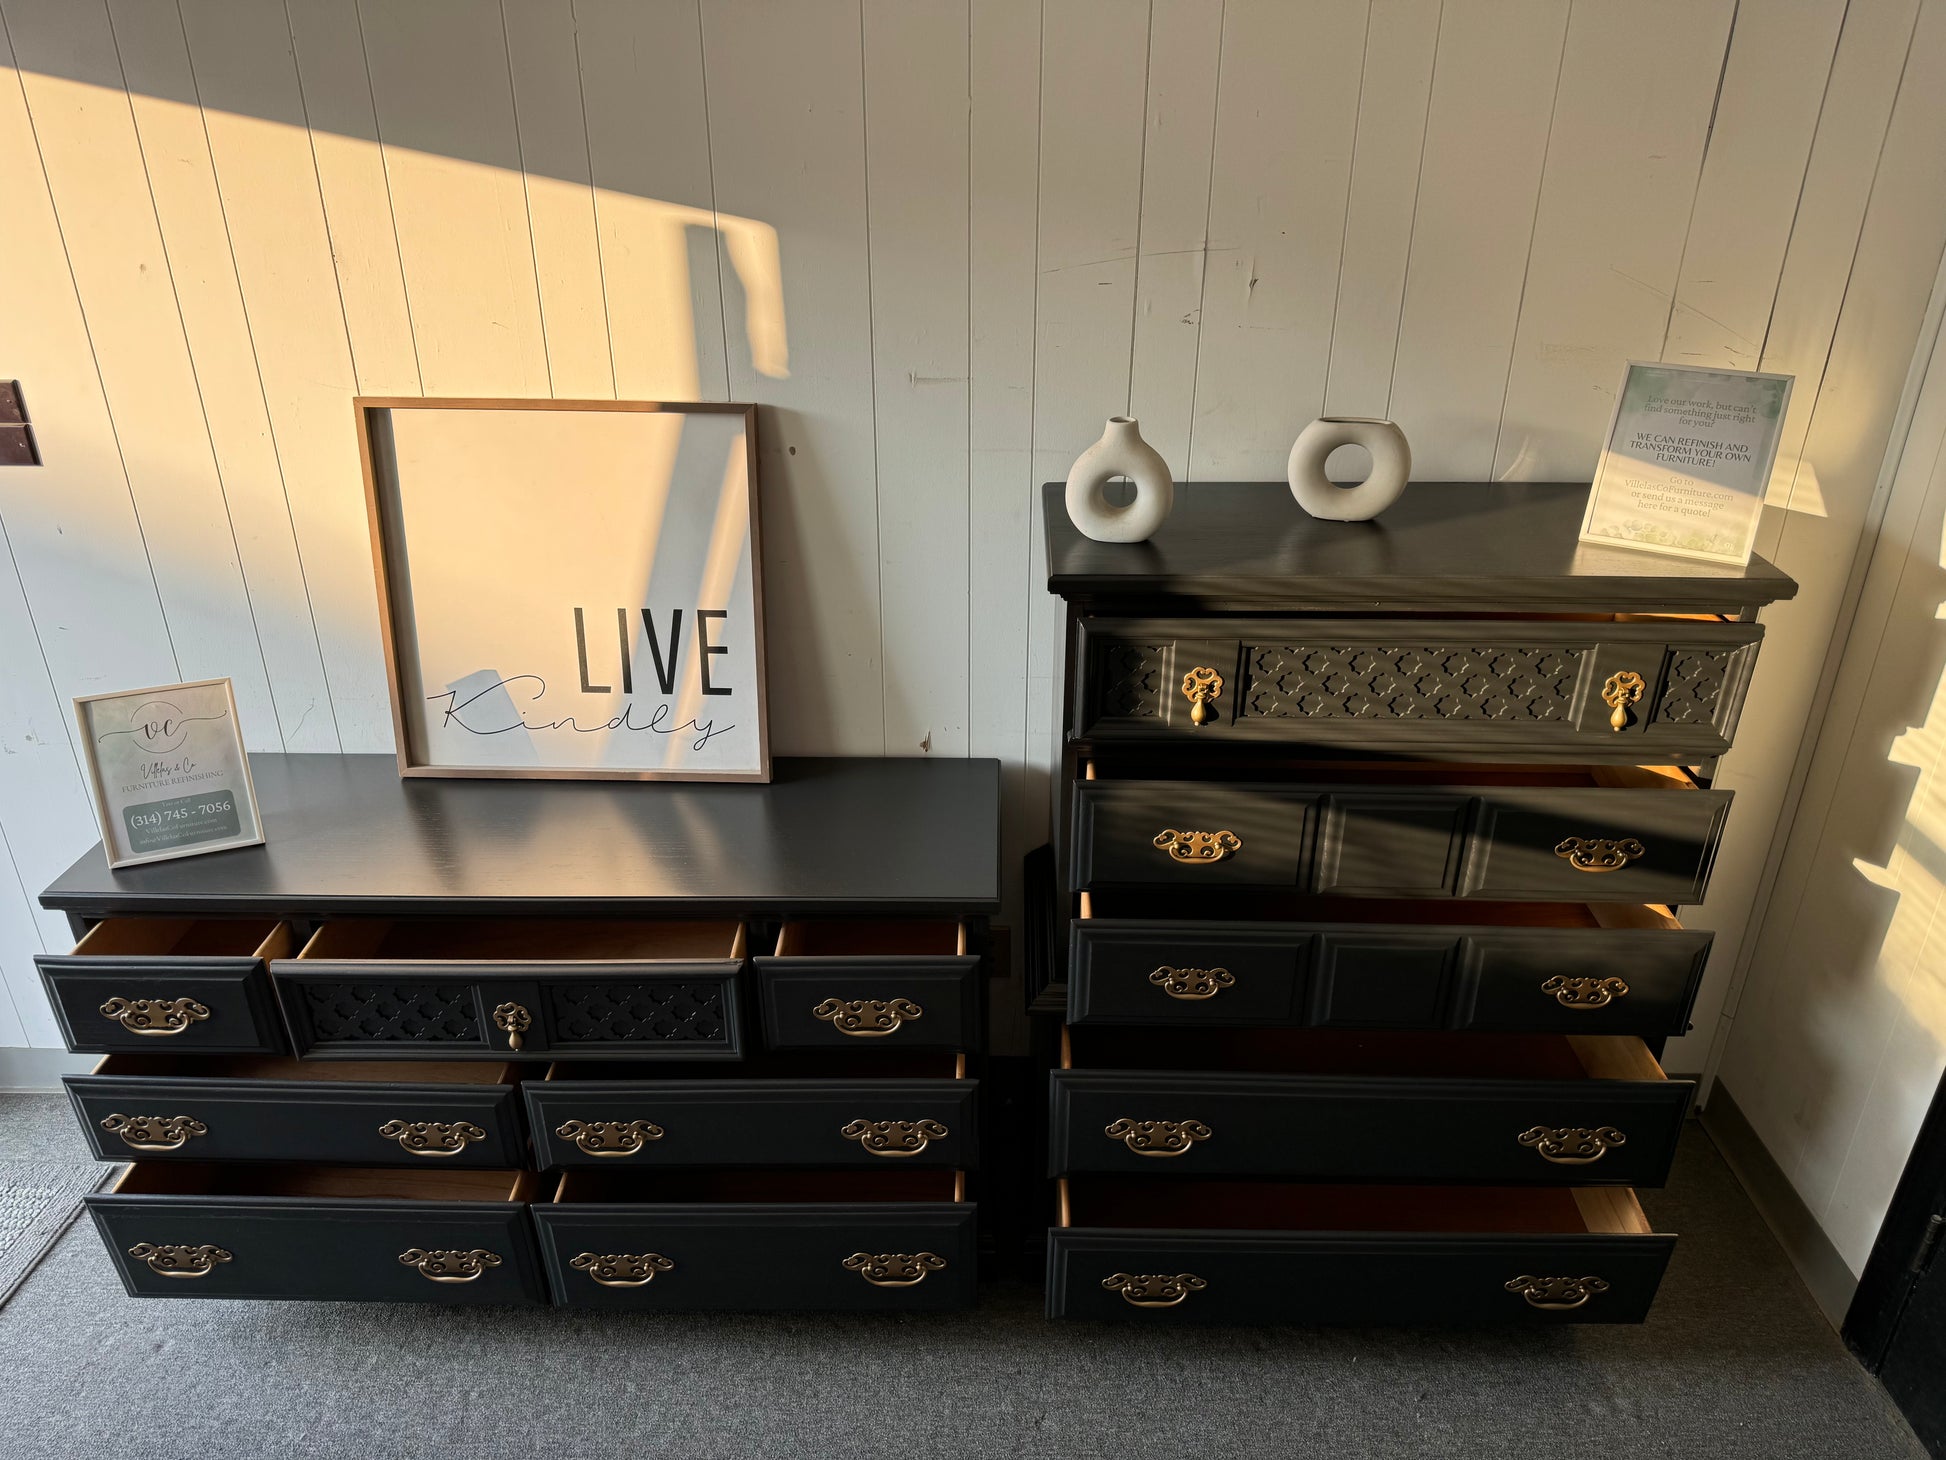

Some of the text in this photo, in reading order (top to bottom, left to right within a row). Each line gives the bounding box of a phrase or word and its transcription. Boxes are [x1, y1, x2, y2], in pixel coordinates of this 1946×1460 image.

[1644, 404, 1756, 424] find something just right
[1648, 395, 1669, 404] Love
[1688, 400, 1714, 410] work,
[1716, 402, 1732, 412] but
[1733, 404, 1757, 414] can't
[1678, 416, 1716, 428] for you?
[1630, 440, 1752, 462] TRANSFORM YOUR OWN
[1637, 432, 1748, 453] WE CAN REFINISH AND
[1656, 453, 1716, 468] FURNITURE!
[1670, 476, 1694, 486] Go to
[1637, 500, 1658, 510] here
[1659, 502, 1672, 512] for
[1680, 507, 1712, 518] quote!
[1642, 490, 1664, 501] send
[1684, 498, 1725, 510] message
[574, 608, 732, 696] LIVE
[426, 675, 736, 750] Kindly
[122, 772, 224, 793] FURNITURE REFINISHING
[130, 811, 162, 830] (314)
[164, 808, 188, 821] 745
[198, 801, 231, 815] 7056
